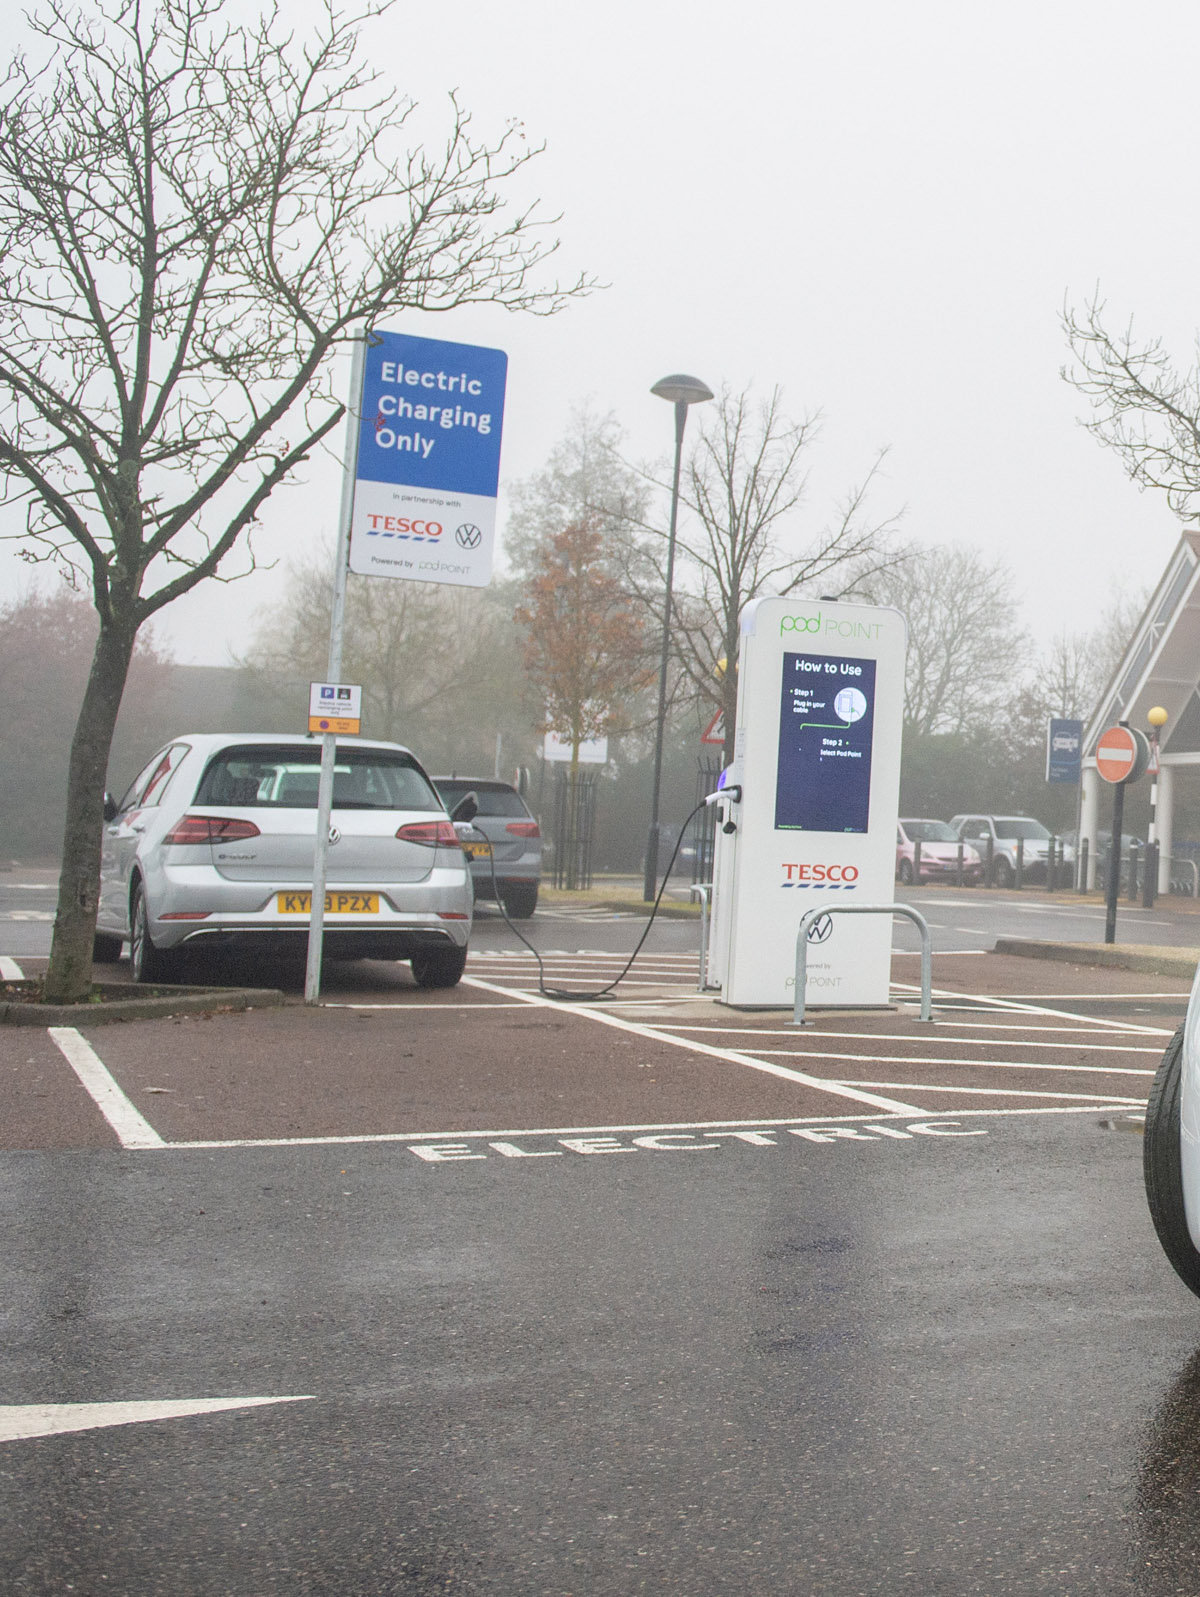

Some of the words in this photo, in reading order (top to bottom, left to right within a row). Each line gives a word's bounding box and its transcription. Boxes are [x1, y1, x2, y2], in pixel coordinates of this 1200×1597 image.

[381, 361, 482, 395] Electric
[378, 395, 492, 435] Charging
[375, 428, 435, 459] Only
[401, 493, 444, 507] partnership
[445, 499, 461, 508] with
[367, 514, 443, 537] TESCO
[371, 556, 403, 567] Powered
[404, 559, 414, 568] by
[441, 564, 471, 575] POINT
[780, 611, 821, 638] pod
[824, 619, 884, 640] POINT
[795, 659, 822, 672] How
[824, 662, 838, 674] to
[840, 663, 862, 676] Use
[794, 688, 810, 697] Step
[793, 699, 806, 708] Plug
[822, 738, 838, 747] Step
[847, 750, 862, 758] Point
[781, 863, 859, 882] TESCO
[285, 896, 332, 911] KY9
[338, 896, 372, 911] PZX
[809, 977, 842, 987] POINT
[407, 1121, 988, 1162] ELECTRIC
